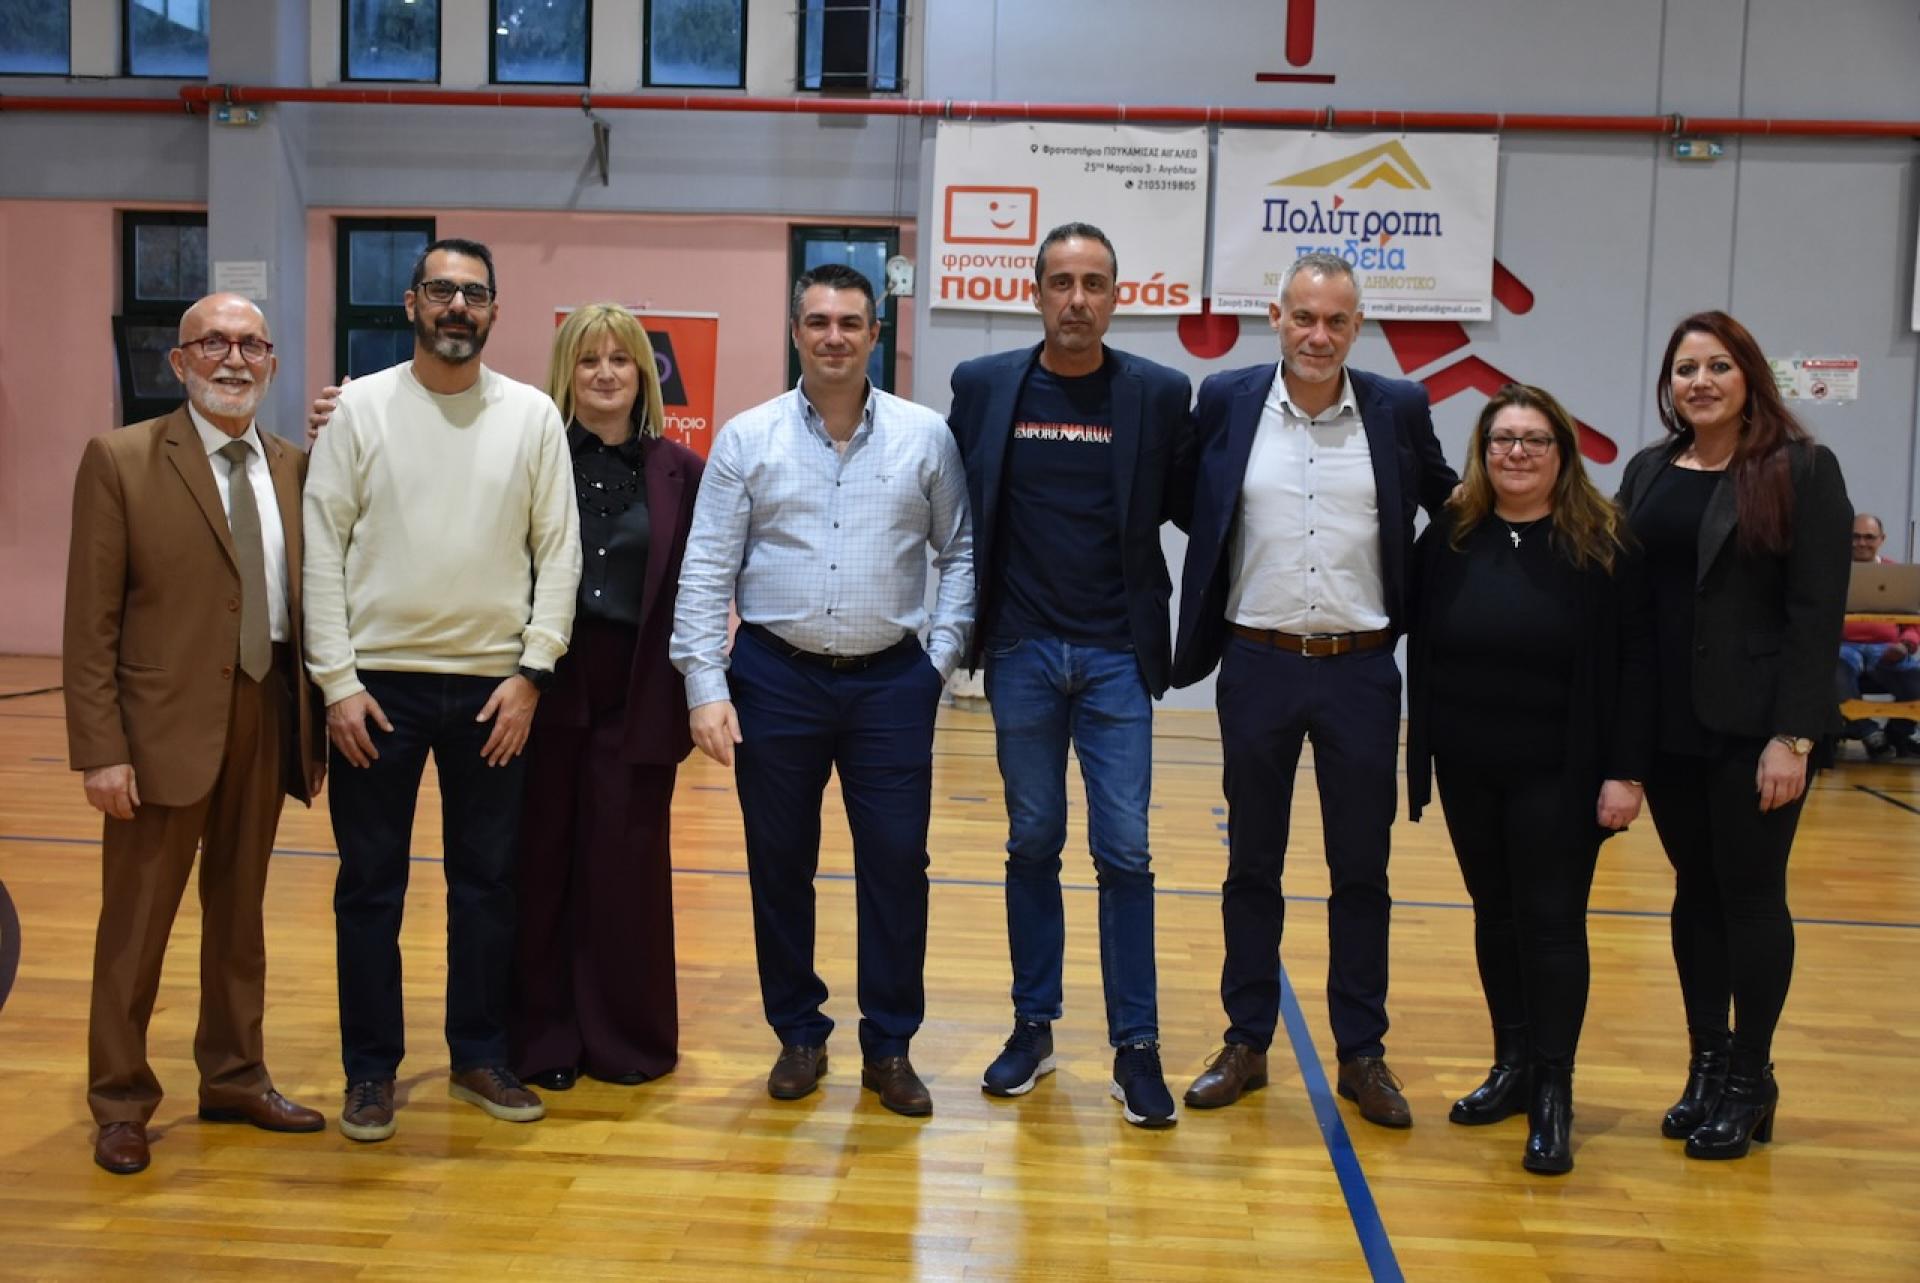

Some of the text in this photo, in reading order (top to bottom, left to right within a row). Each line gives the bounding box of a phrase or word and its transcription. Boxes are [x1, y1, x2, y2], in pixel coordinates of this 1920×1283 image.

[1043, 145, 1102, 157] Φροντιστήριο
[1103, 146, 1159, 157] ΠΟΥΚΑΜΙΣΑΣ
[1145, 163, 1151, 174] 3
[1137, 179, 1196, 191] 2105319805
[1262, 194, 1442, 242] Πολύτροπη
[1363, 276, 1436, 290] ΔΗΜΟΤΙΚΟ
[1014, 422, 1063, 441] EMPORIO
